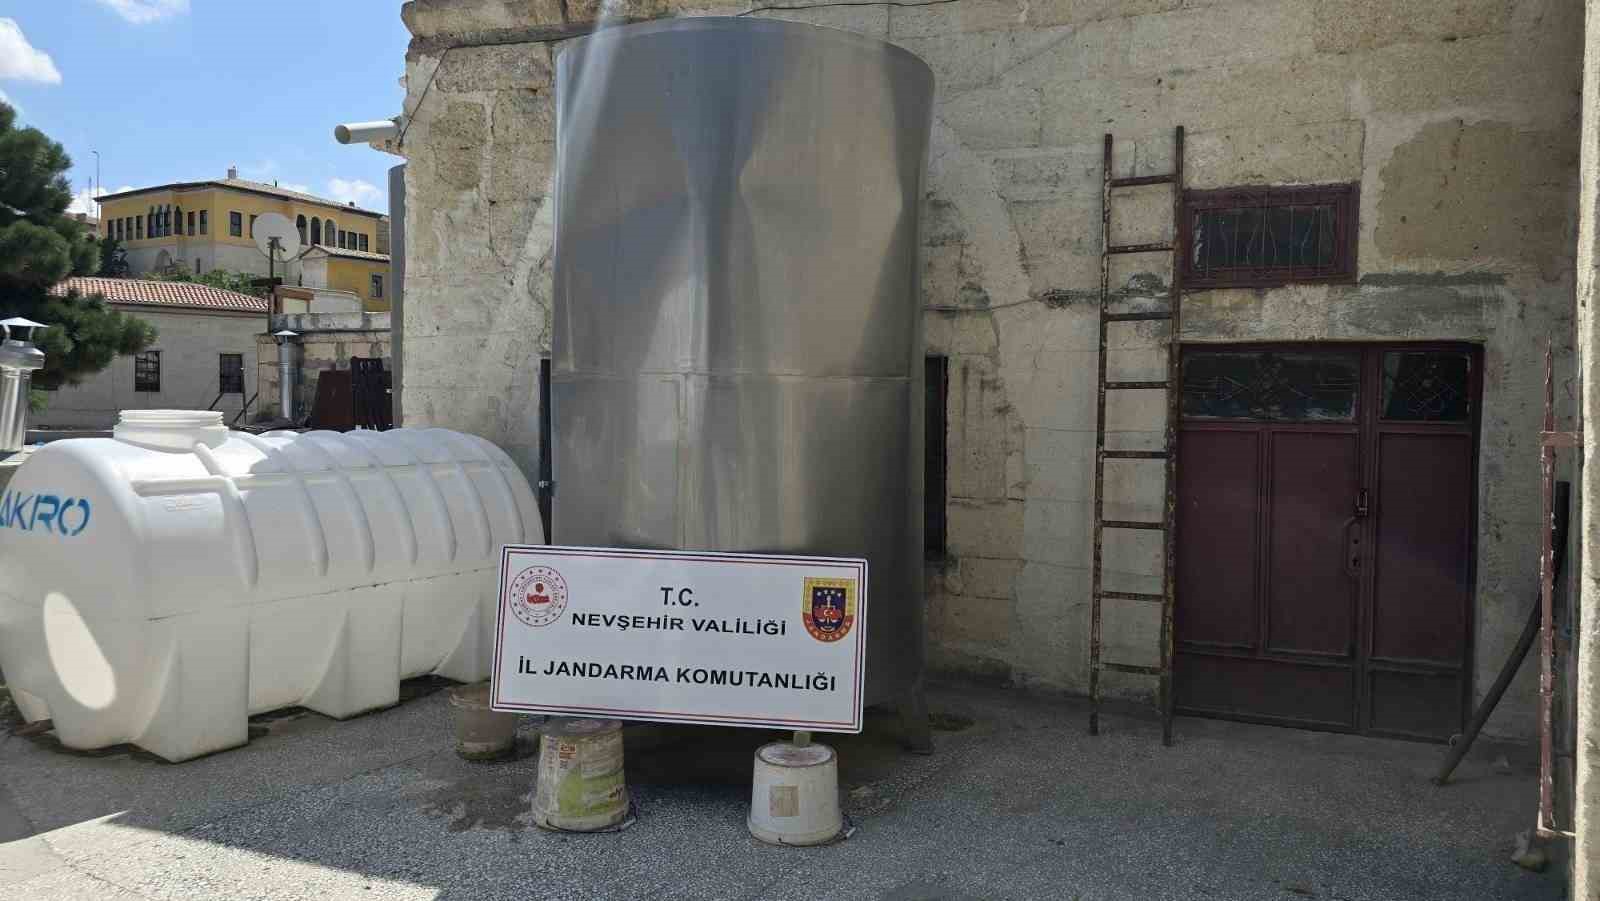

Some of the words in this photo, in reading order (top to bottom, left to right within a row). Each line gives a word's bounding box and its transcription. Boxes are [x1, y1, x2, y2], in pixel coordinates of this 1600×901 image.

[660, 586, 700, 608] T.C.
[571, 612, 685, 632] NEVŞEHİR
[691, 618, 787, 636] VALİLİĞİ
[518, 655, 537, 675] İL
[543, 660, 670, 683] JANDARMA
[676, 667, 836, 692] KOMUTANLIĞI
